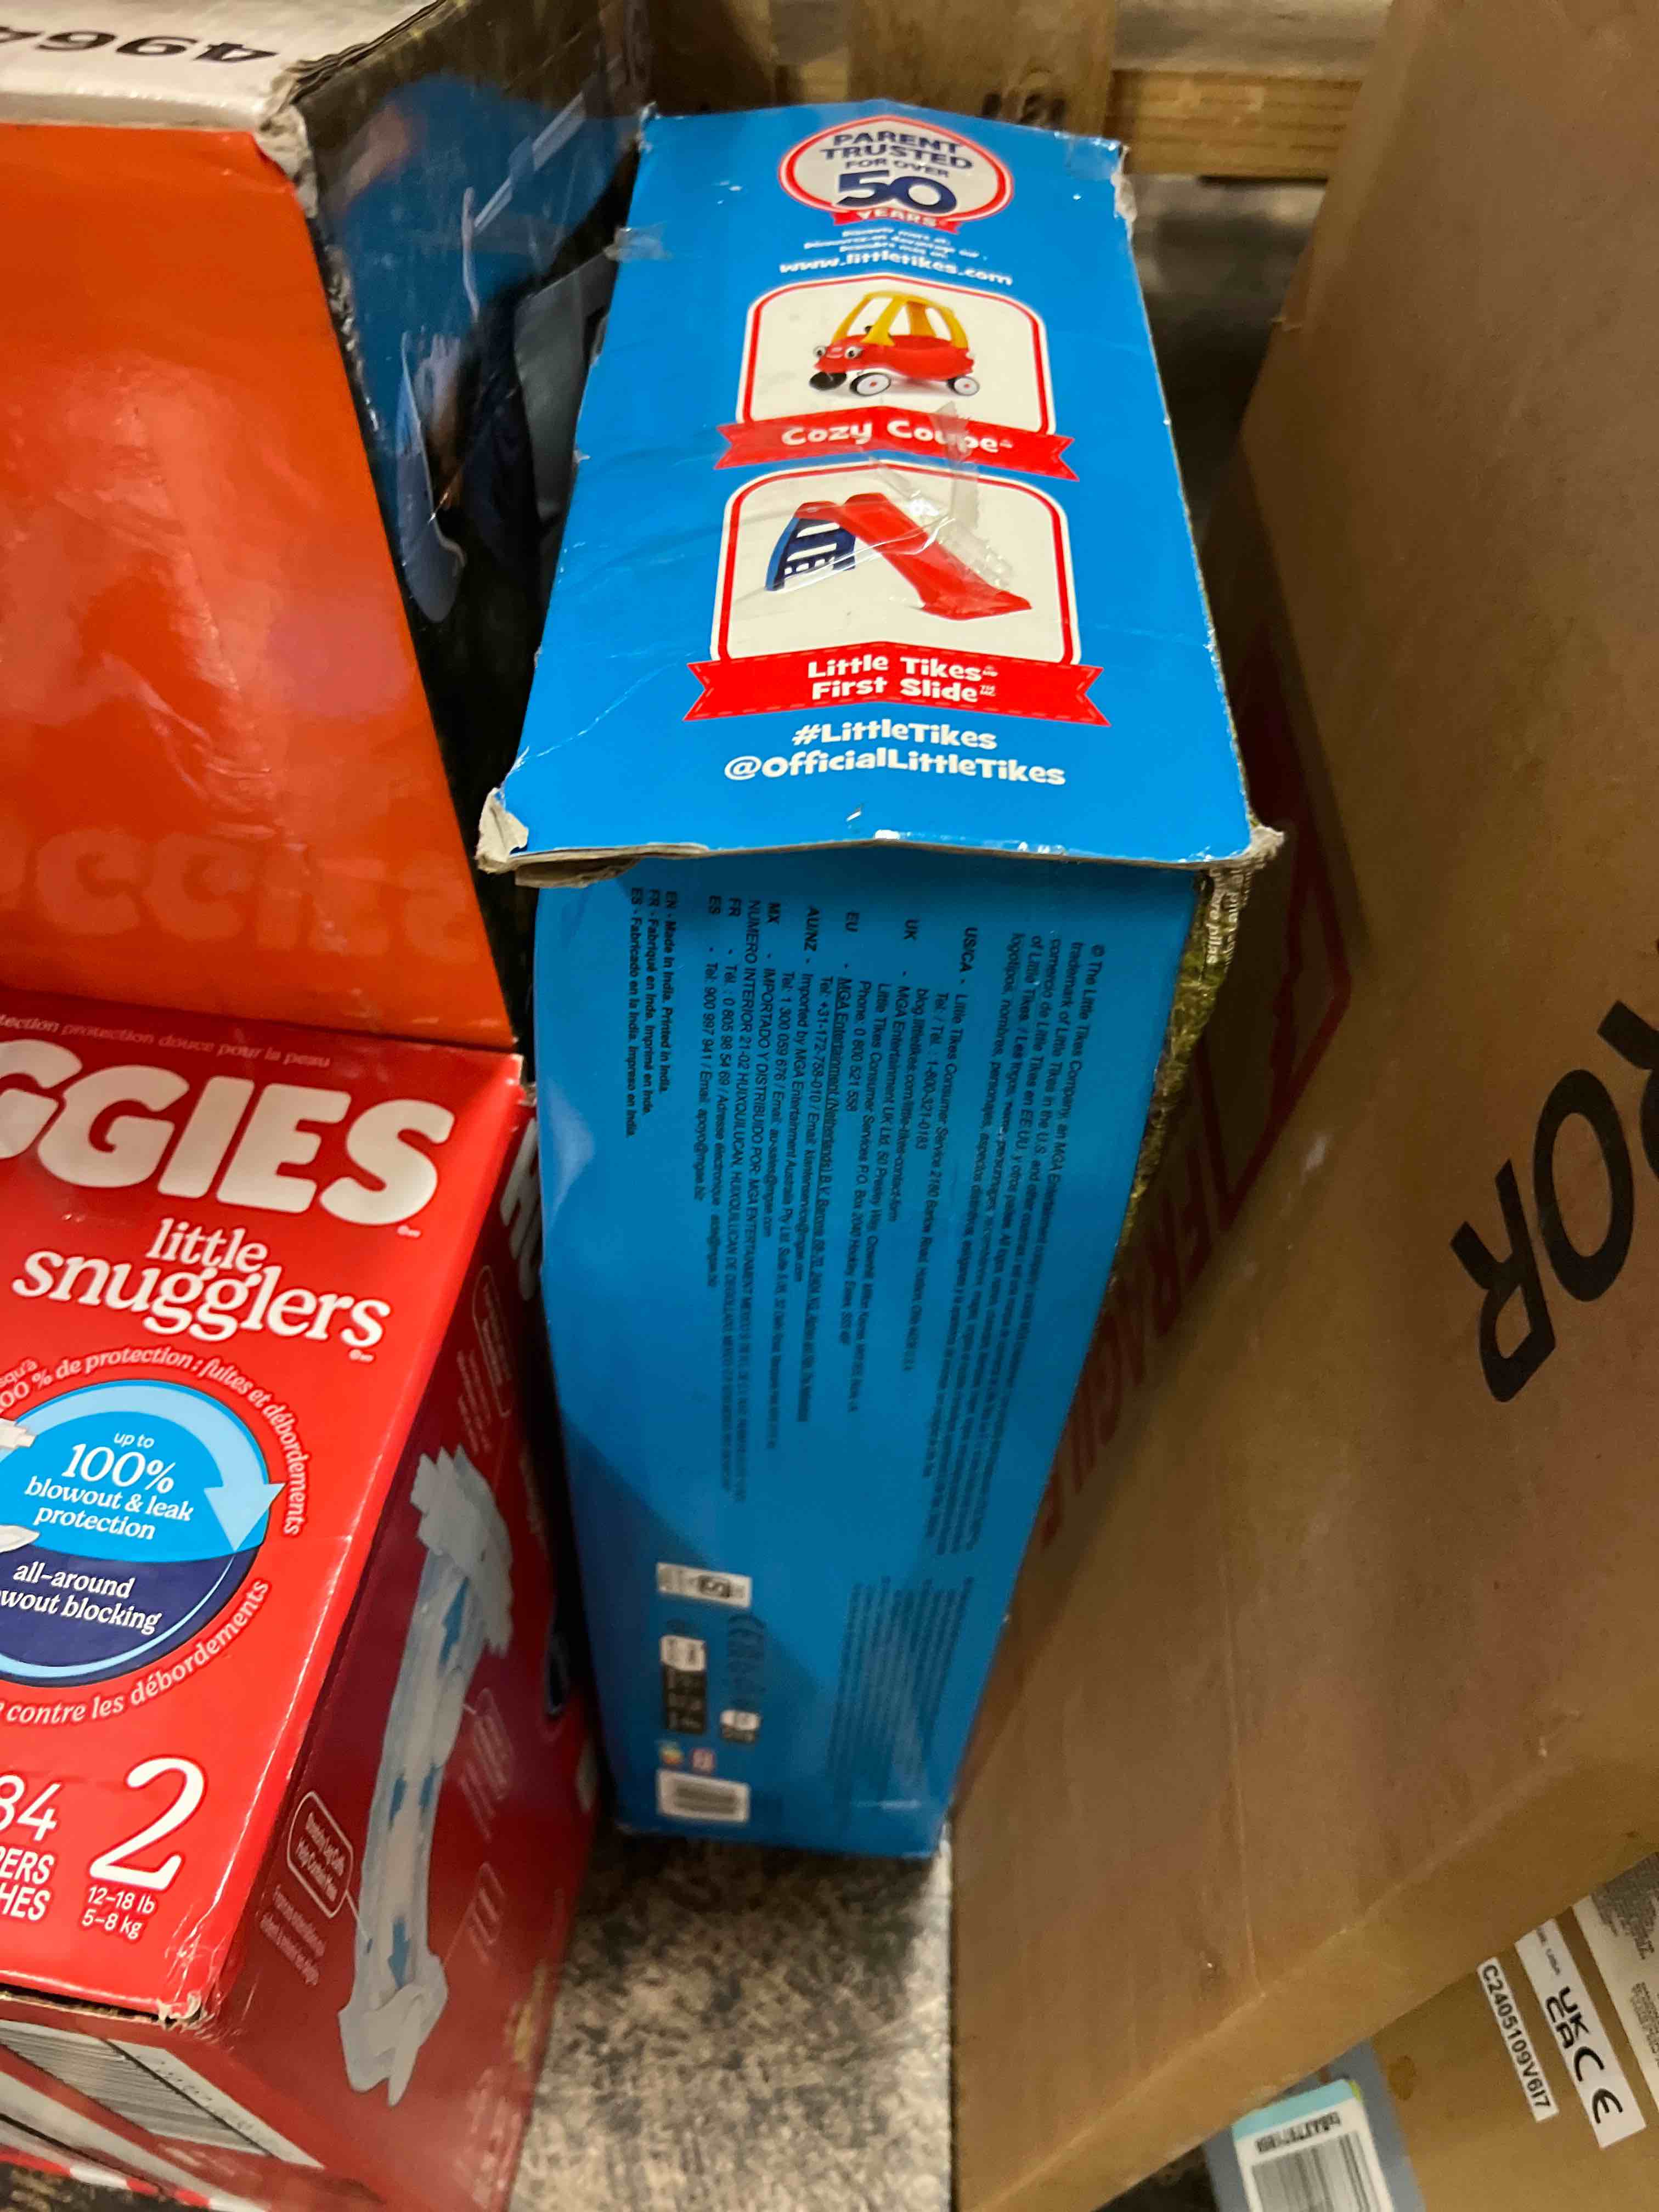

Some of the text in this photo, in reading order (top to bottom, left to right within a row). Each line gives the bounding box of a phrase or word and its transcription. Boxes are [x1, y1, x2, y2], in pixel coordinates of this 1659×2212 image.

[820, 144, 973, 169] TRUSTED
[833, 131, 962, 154] PARENT
[845, 157, 949, 177] FOR OVER
[836, 170, 957, 215] 50
[857, 208, 937, 227] YEARS
[779, 250, 1013, 285] www.littletikes.com
[782, 422, 873, 445] Cozy
[808, 654, 982, 681] Little Tikes
[811, 676, 978, 703] First Slide
[791, 718, 997, 750] #LittleTikes
[724, 747, 1066, 786] @OfficialLittleTikes
[630, 887, 642, 905] ES
[664, 890, 676, 909] EN
[709, 894, 722, 915] ES
[729, 897, 742, 918] FR
[768, 902, 780, 926] MX
[844, 911, 858, 933] EU
[905, 918, 918, 941] UK
[629, 917, 641, 977] Fabricado
[644, 918, 659, 972] Fabriqué
[663, 921, 675, 953] Made
[745, 899, 761, 964] NUMERO
[1024, 951, 1040, 984] Little
[740, 967, 756, 1032] INTERIOR
[758, 967, 777, 1049] IMPORTADO
[795, 973, 814, 1028] Imported
[836, 977, 851, 1009] MGA
[874, 983, 890, 1013] Little
[894, 985, 909, 1018] MGA
[951, 993, 967, 1024] Little
[1079, 989, 1096, 1019] Little
[660, 1007, 673, 1048] Printed
[870, 1015, 885, 1048] Tikes
[946, 1026, 962, 1060] Tikes
[1031, 1021, 1048, 1052] Little
[1052, 1027, 1068, 1057] Little
[1072, 1024, 1090, 1057] Tikes
[217, 1042, 264, 1059] pour
[264, 1047, 281, 1061] la
[283, 1052, 331, 1068] peau
[624, 1045, 639, 1091] Impreso
[793, 1047, 808, 1079] MGA
[145, 1217, 268, 1272] little
[12, 1249, 392, 1347] snugglers
[55, 1359, 82, 1379] de
[199, 1358, 255, 1395] fuites
[247, 1386, 273, 1408] et
[263, 1402, 311, 1536] débordements
[114, 1431, 155, 1448] up to
[61, 1442, 176, 1494] 100%
[24, 1475, 194, 1522] blowout & leak
[33, 1506, 156, 1541] protection
[13, 1561, 136, 1599] all-around
[60, 1594, 162, 1636] blocking
[7, 1579, 269, 1725] contre les débordements
[89, 1757, 205, 1891] 2
[0, 1846, 55, 1884] ERS
[137, 1894, 156, 1914] lb
[119, 1914, 143, 1940] kg
